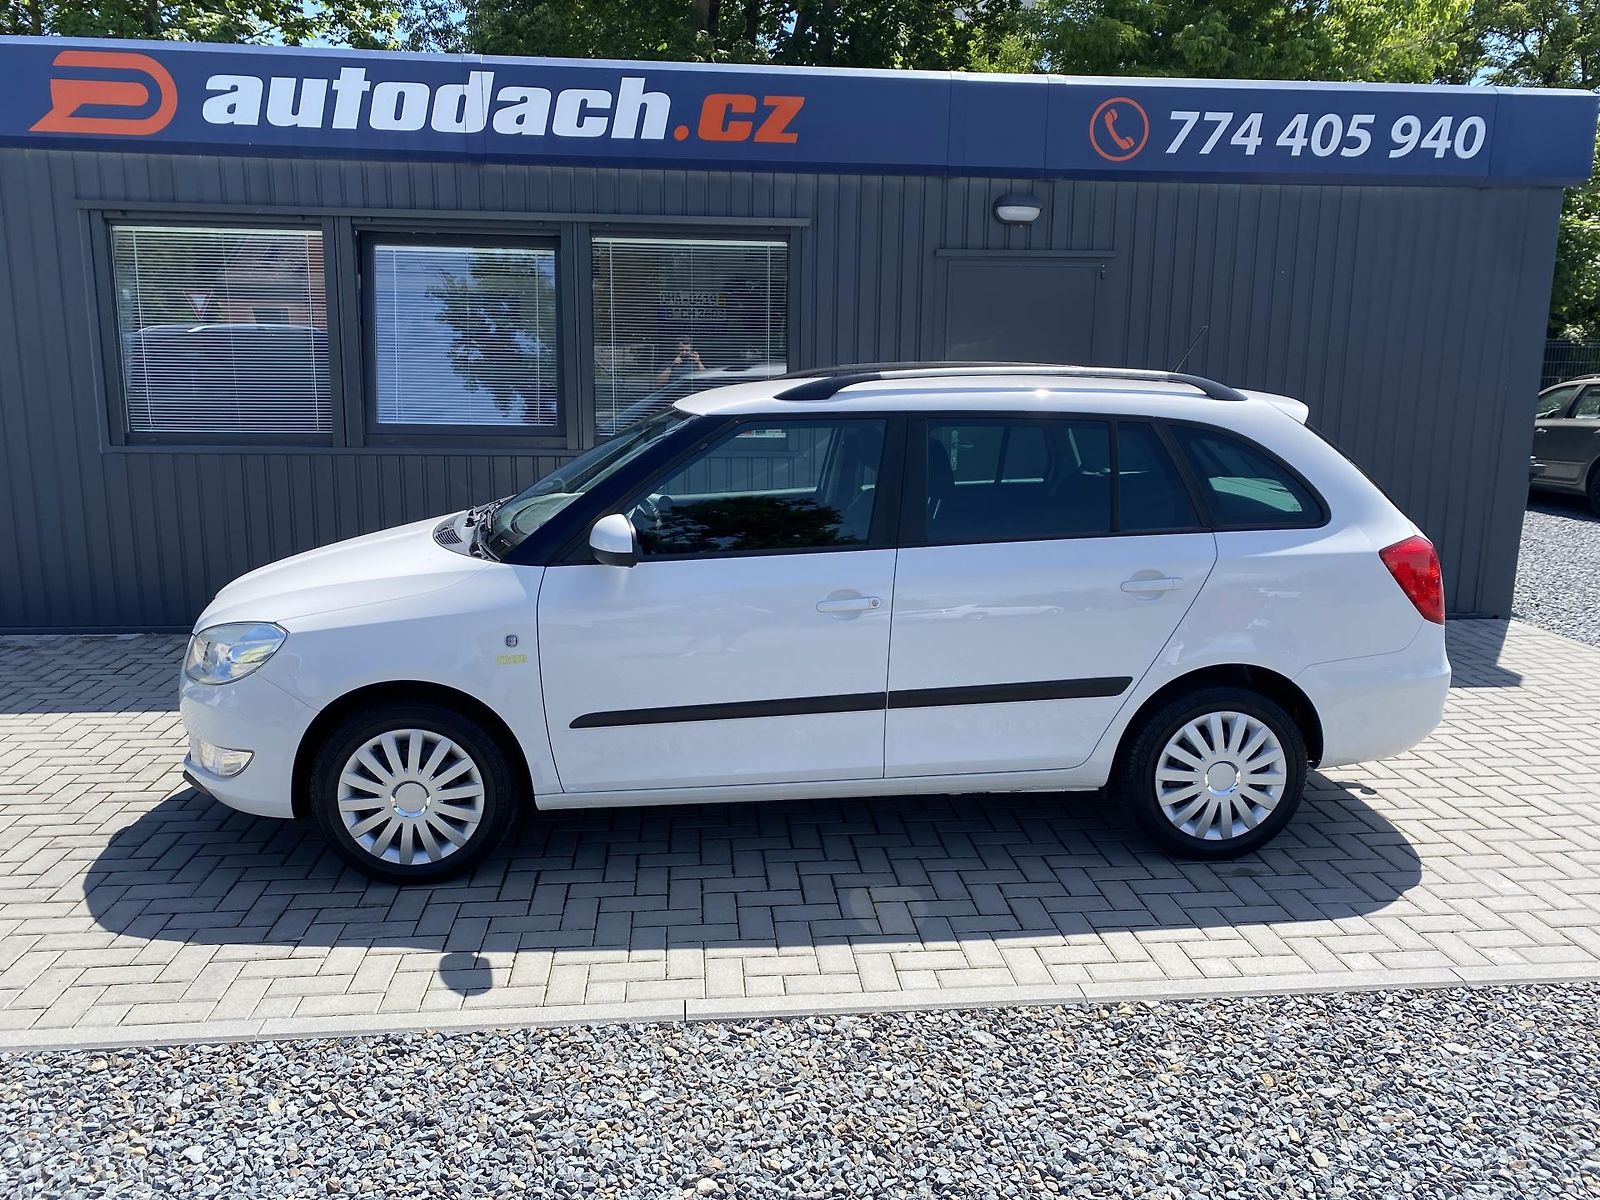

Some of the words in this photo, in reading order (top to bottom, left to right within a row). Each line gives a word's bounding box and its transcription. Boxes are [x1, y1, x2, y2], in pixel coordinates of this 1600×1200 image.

[203, 67, 804, 143] autodach.cz
[1165, 110, 1264, 156] 774
[1275, 113, 1376, 157] 405
[1388, 115, 1487, 159] 940
